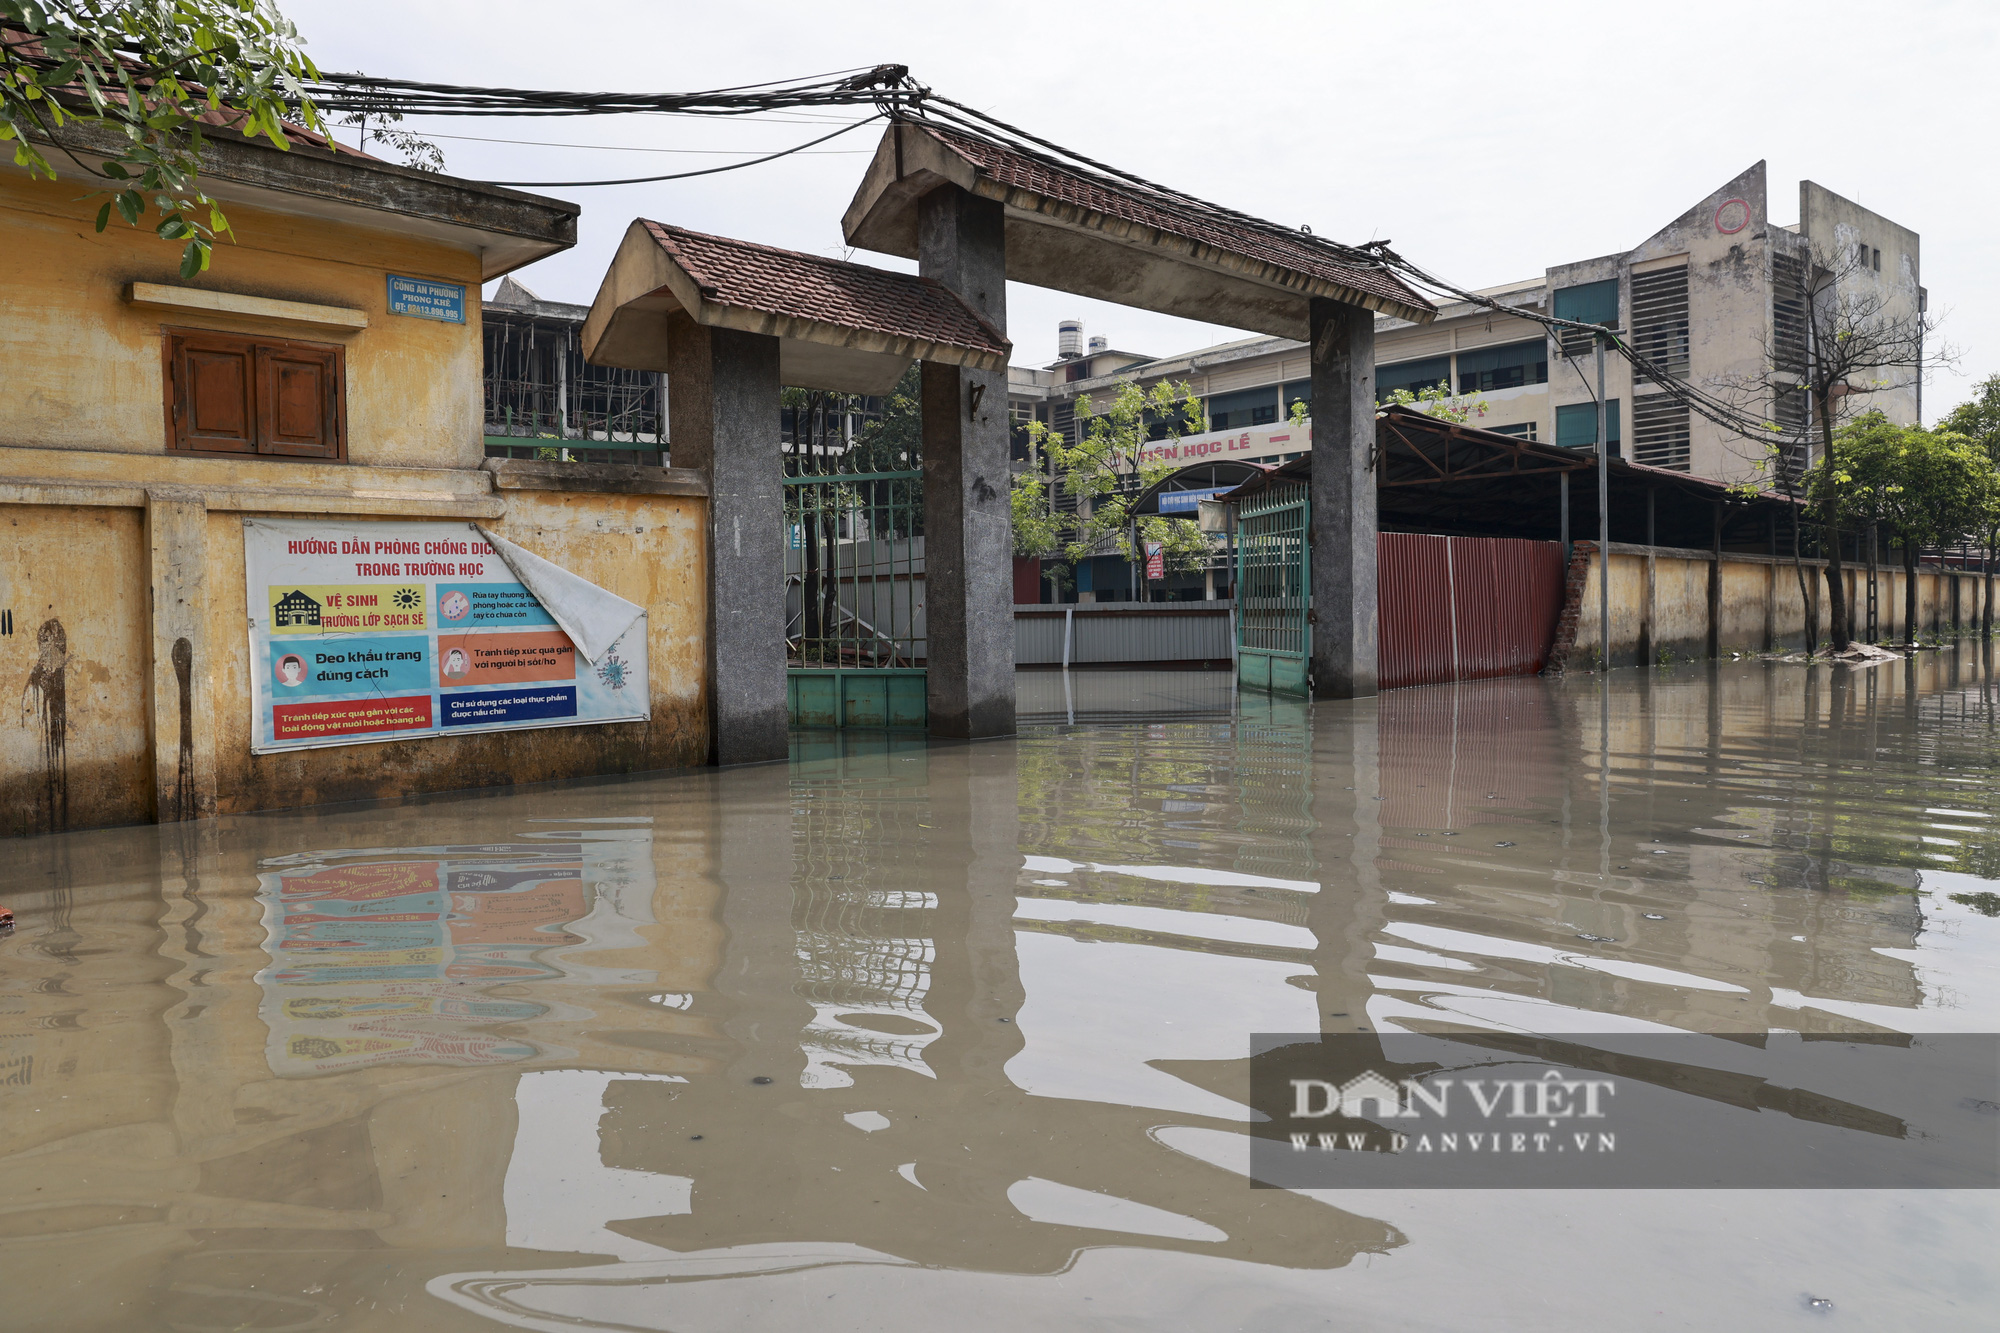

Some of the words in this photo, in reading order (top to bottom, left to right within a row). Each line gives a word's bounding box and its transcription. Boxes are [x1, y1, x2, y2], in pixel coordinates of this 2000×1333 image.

[393, 281, 415, 292] CÔNG
[416, 286, 428, 295] AN
[429, 286, 459, 299] PHƯỜNG
[402, 293, 432, 304] PHONG
[1183, 441, 1222, 457] HỌC
[288, 537, 338, 555] HƯỚNG
[342, 535, 371, 555] DẪN
[374, 538, 421, 555] PHÒNG
[424, 537, 467, 555] CHỐNG
[471, 542, 498, 558] DỊC
[355, 562, 400, 577] TRONG
[404, 559, 455, 577] TRƯỜNG
[459, 562, 484, 578] HỌC
[325, 592, 342, 610] VỆ
[346, 594, 378, 607] SINH
[488, 592, 499, 600] tay
[320, 612, 360, 628] TRƯỜNG
[362, 611, 381, 627] LỚP
[383, 613, 409, 629] SẠCH
[473, 612, 485, 620] tay
[315, 653, 346, 665] Đeo
[348, 648, 383, 663] khẩu
[385, 650, 422, 663] trang
[474, 648, 502, 657] Tránh
[503, 646, 521, 658] tiếp
[522, 646, 537, 655] xúc
[538, 645, 555, 656] quá
[556, 644, 573, 656] gần
[474, 660, 489, 669] với
[517, 658, 526, 668] bị
[316, 670, 353, 683] đúng
[476, 698, 498, 708] dụng
[498, 697, 512, 705] các
[513, 695, 528, 705] loại
[281, 711, 311, 723] Tránh
[311, 710, 330, 722] tiếp
[330, 710, 347, 719] xúc
[347, 709, 366, 719] quá
[398, 706, 414, 715] các
[473, 707, 489, 717] nấu
[489, 706, 507, 715] chín
[300, 721, 326, 732] động
[326, 720, 342, 731] vật
[386, 715, 414, 726] hoang
